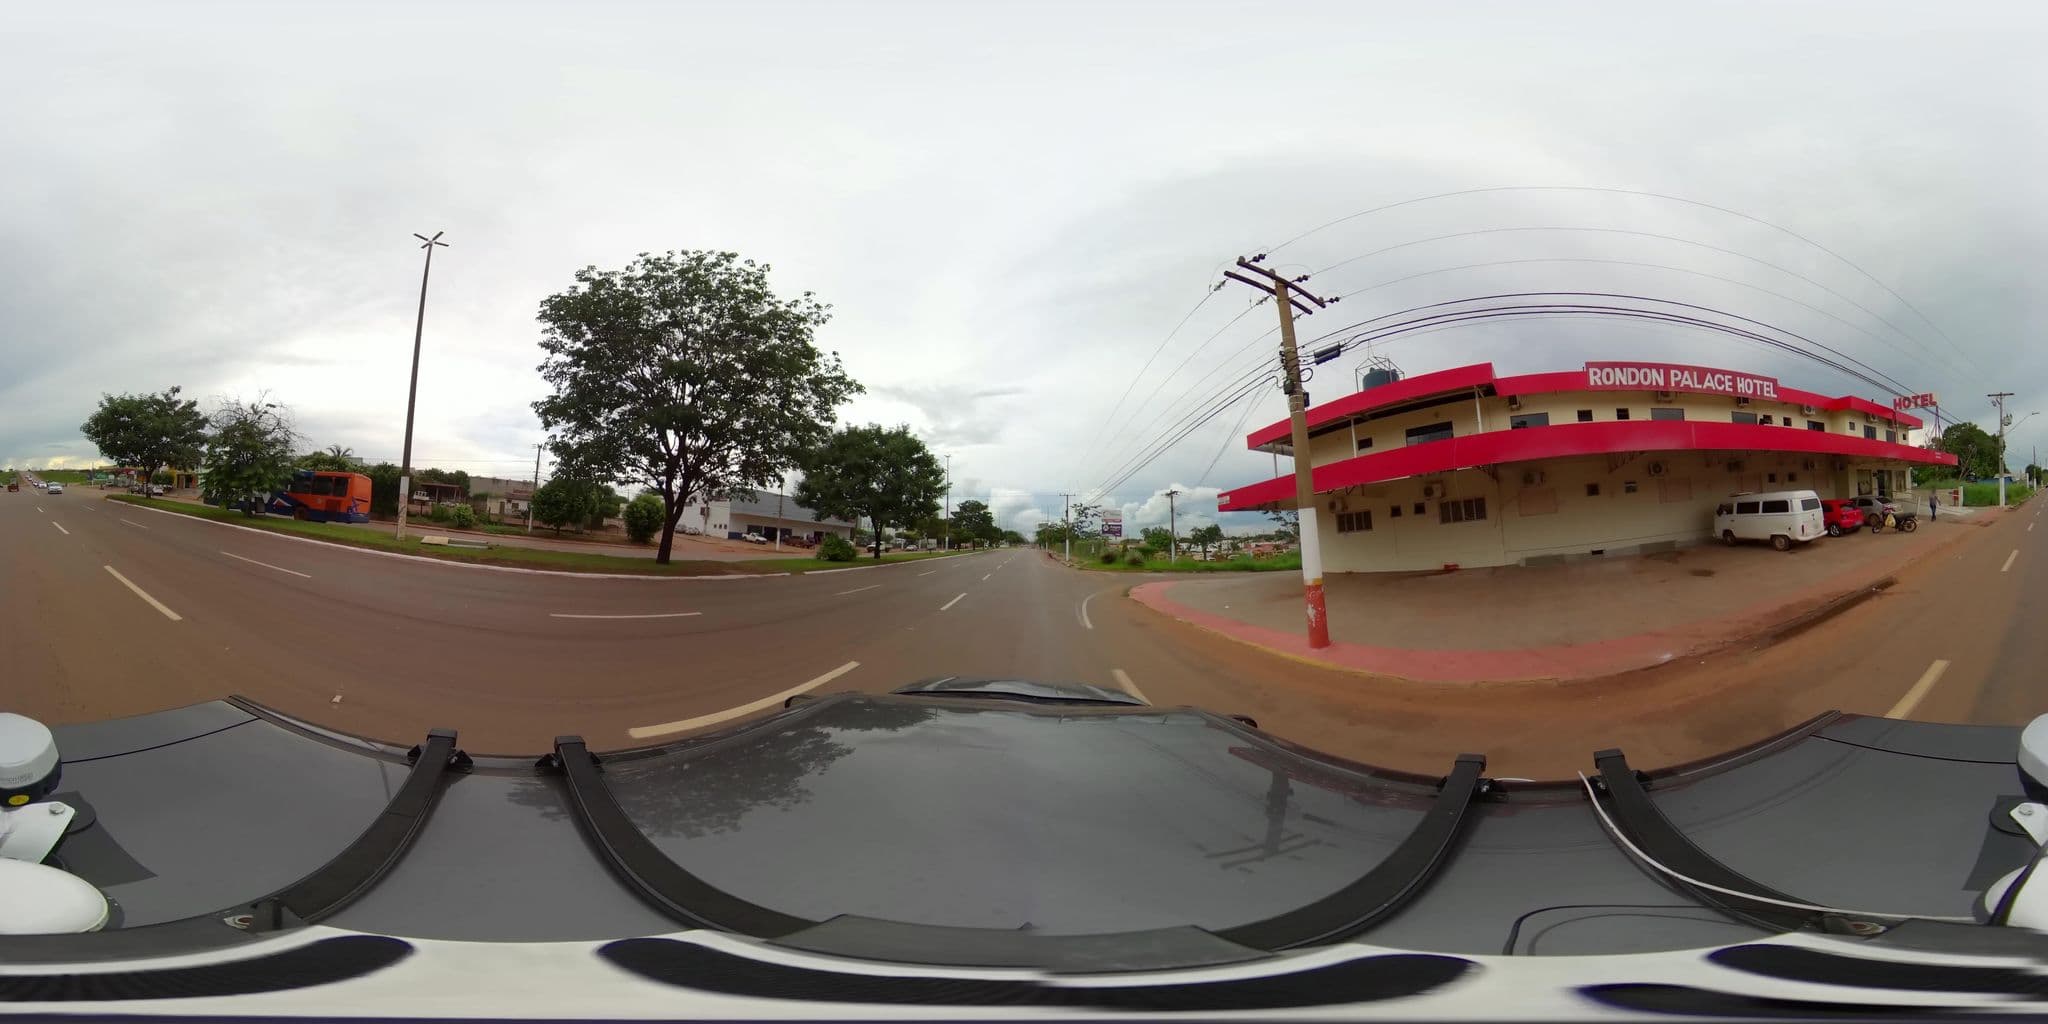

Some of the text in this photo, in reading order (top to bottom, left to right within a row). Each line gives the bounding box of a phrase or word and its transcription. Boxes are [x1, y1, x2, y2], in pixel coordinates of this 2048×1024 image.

[1588, 367, 1778, 398] RONDON PALACE HOTEL
[1893, 393, 1937, 410] HOTEL
